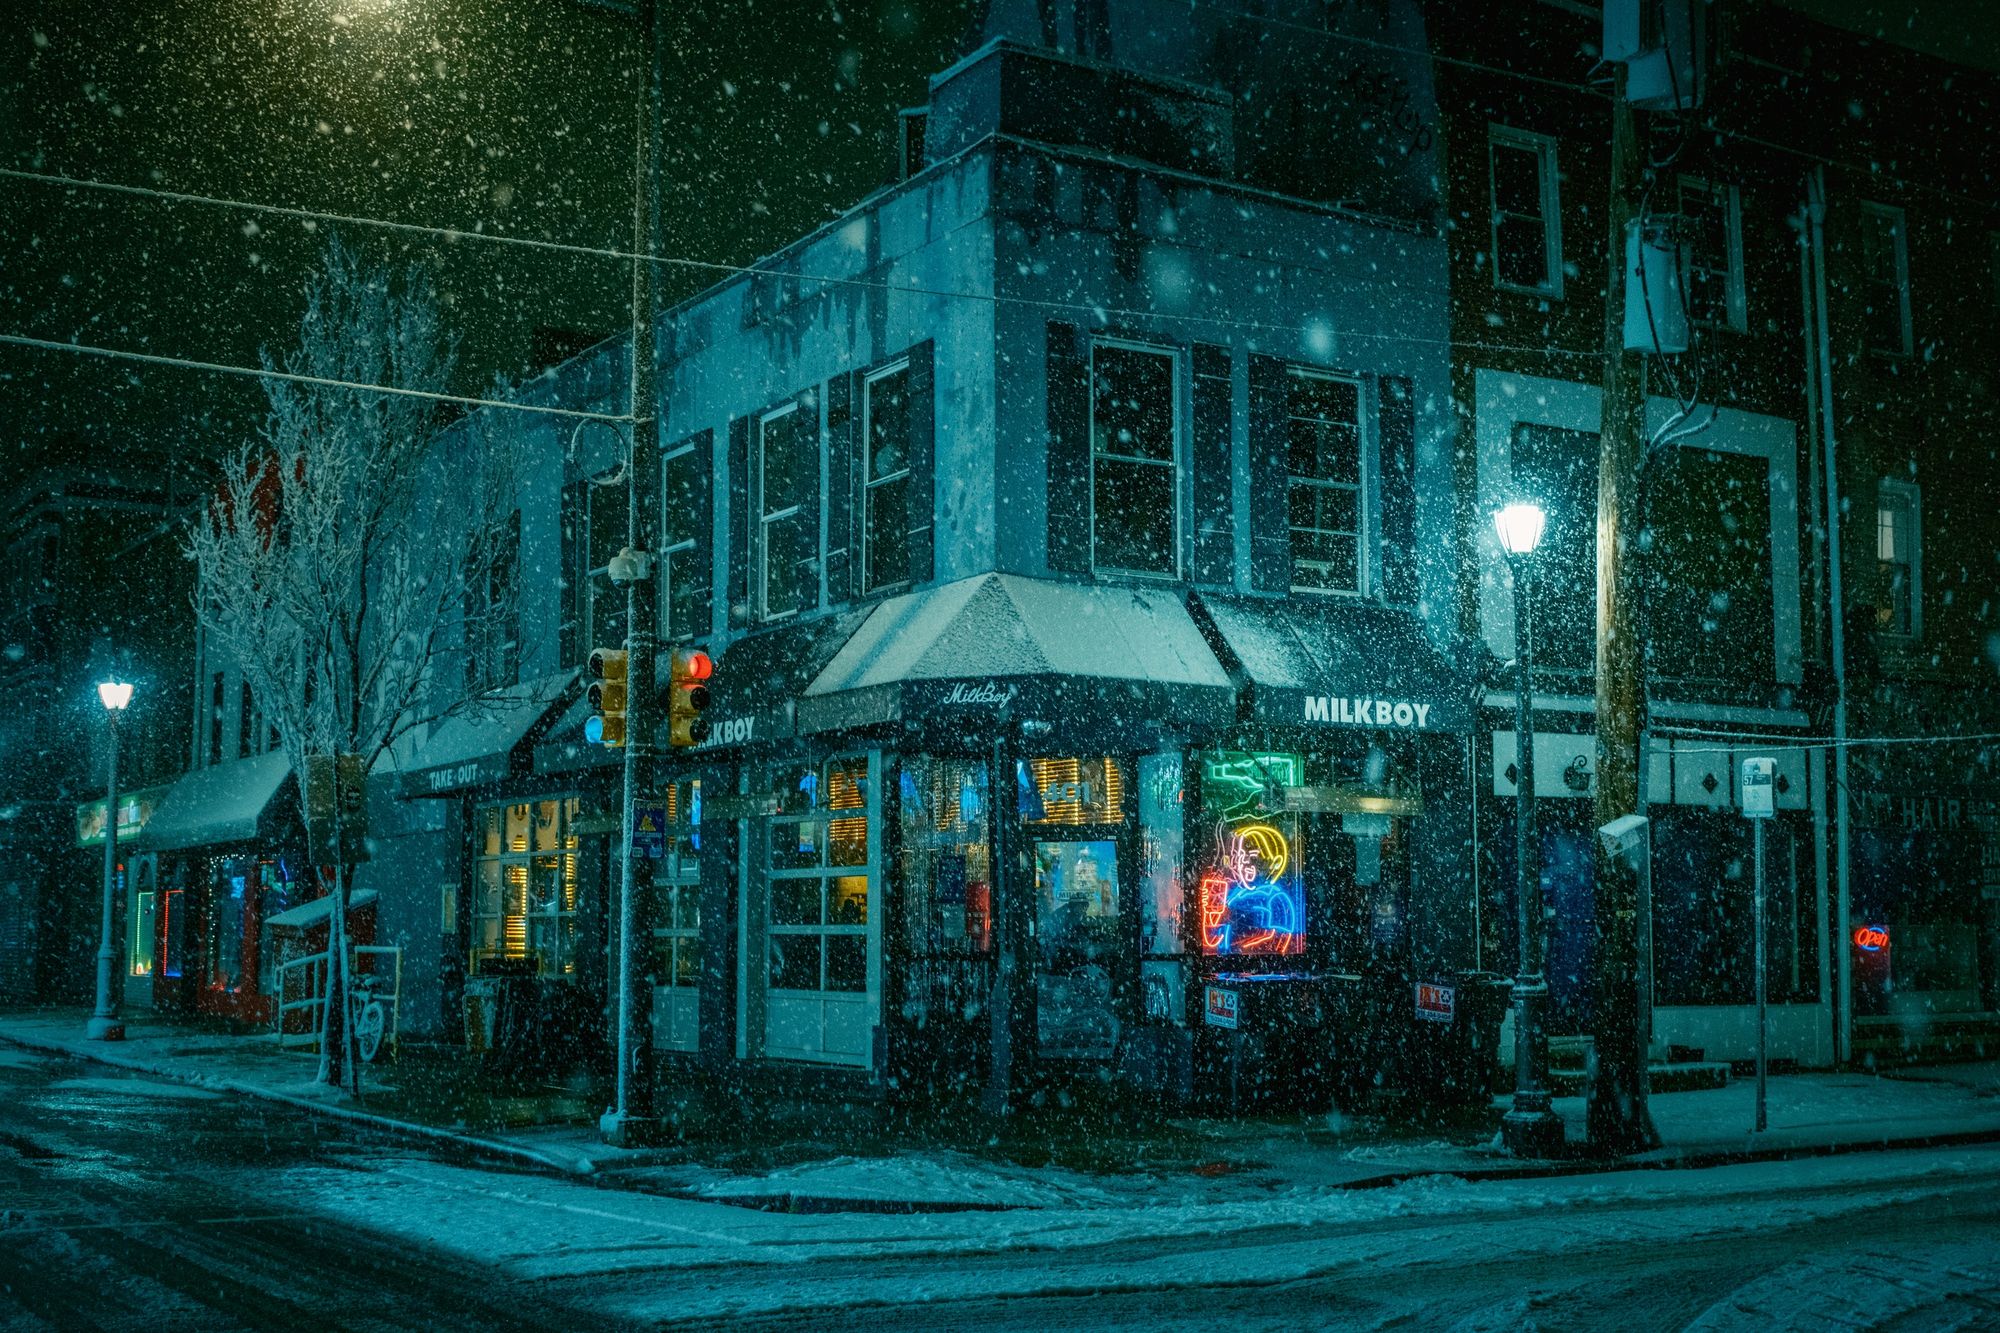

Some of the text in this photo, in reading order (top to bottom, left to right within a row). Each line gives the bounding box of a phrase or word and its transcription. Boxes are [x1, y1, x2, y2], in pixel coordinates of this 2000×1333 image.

[943, 681, 1013, 709] MilkBoy
[1304, 696, 1431, 728] MILKBOY
[429, 763, 478, 790] TAKE OUT
[1744, 775, 1754, 785] 57
[1042, 781, 1091, 803] 401
[1902, 798, 1961, 831] HAIR
